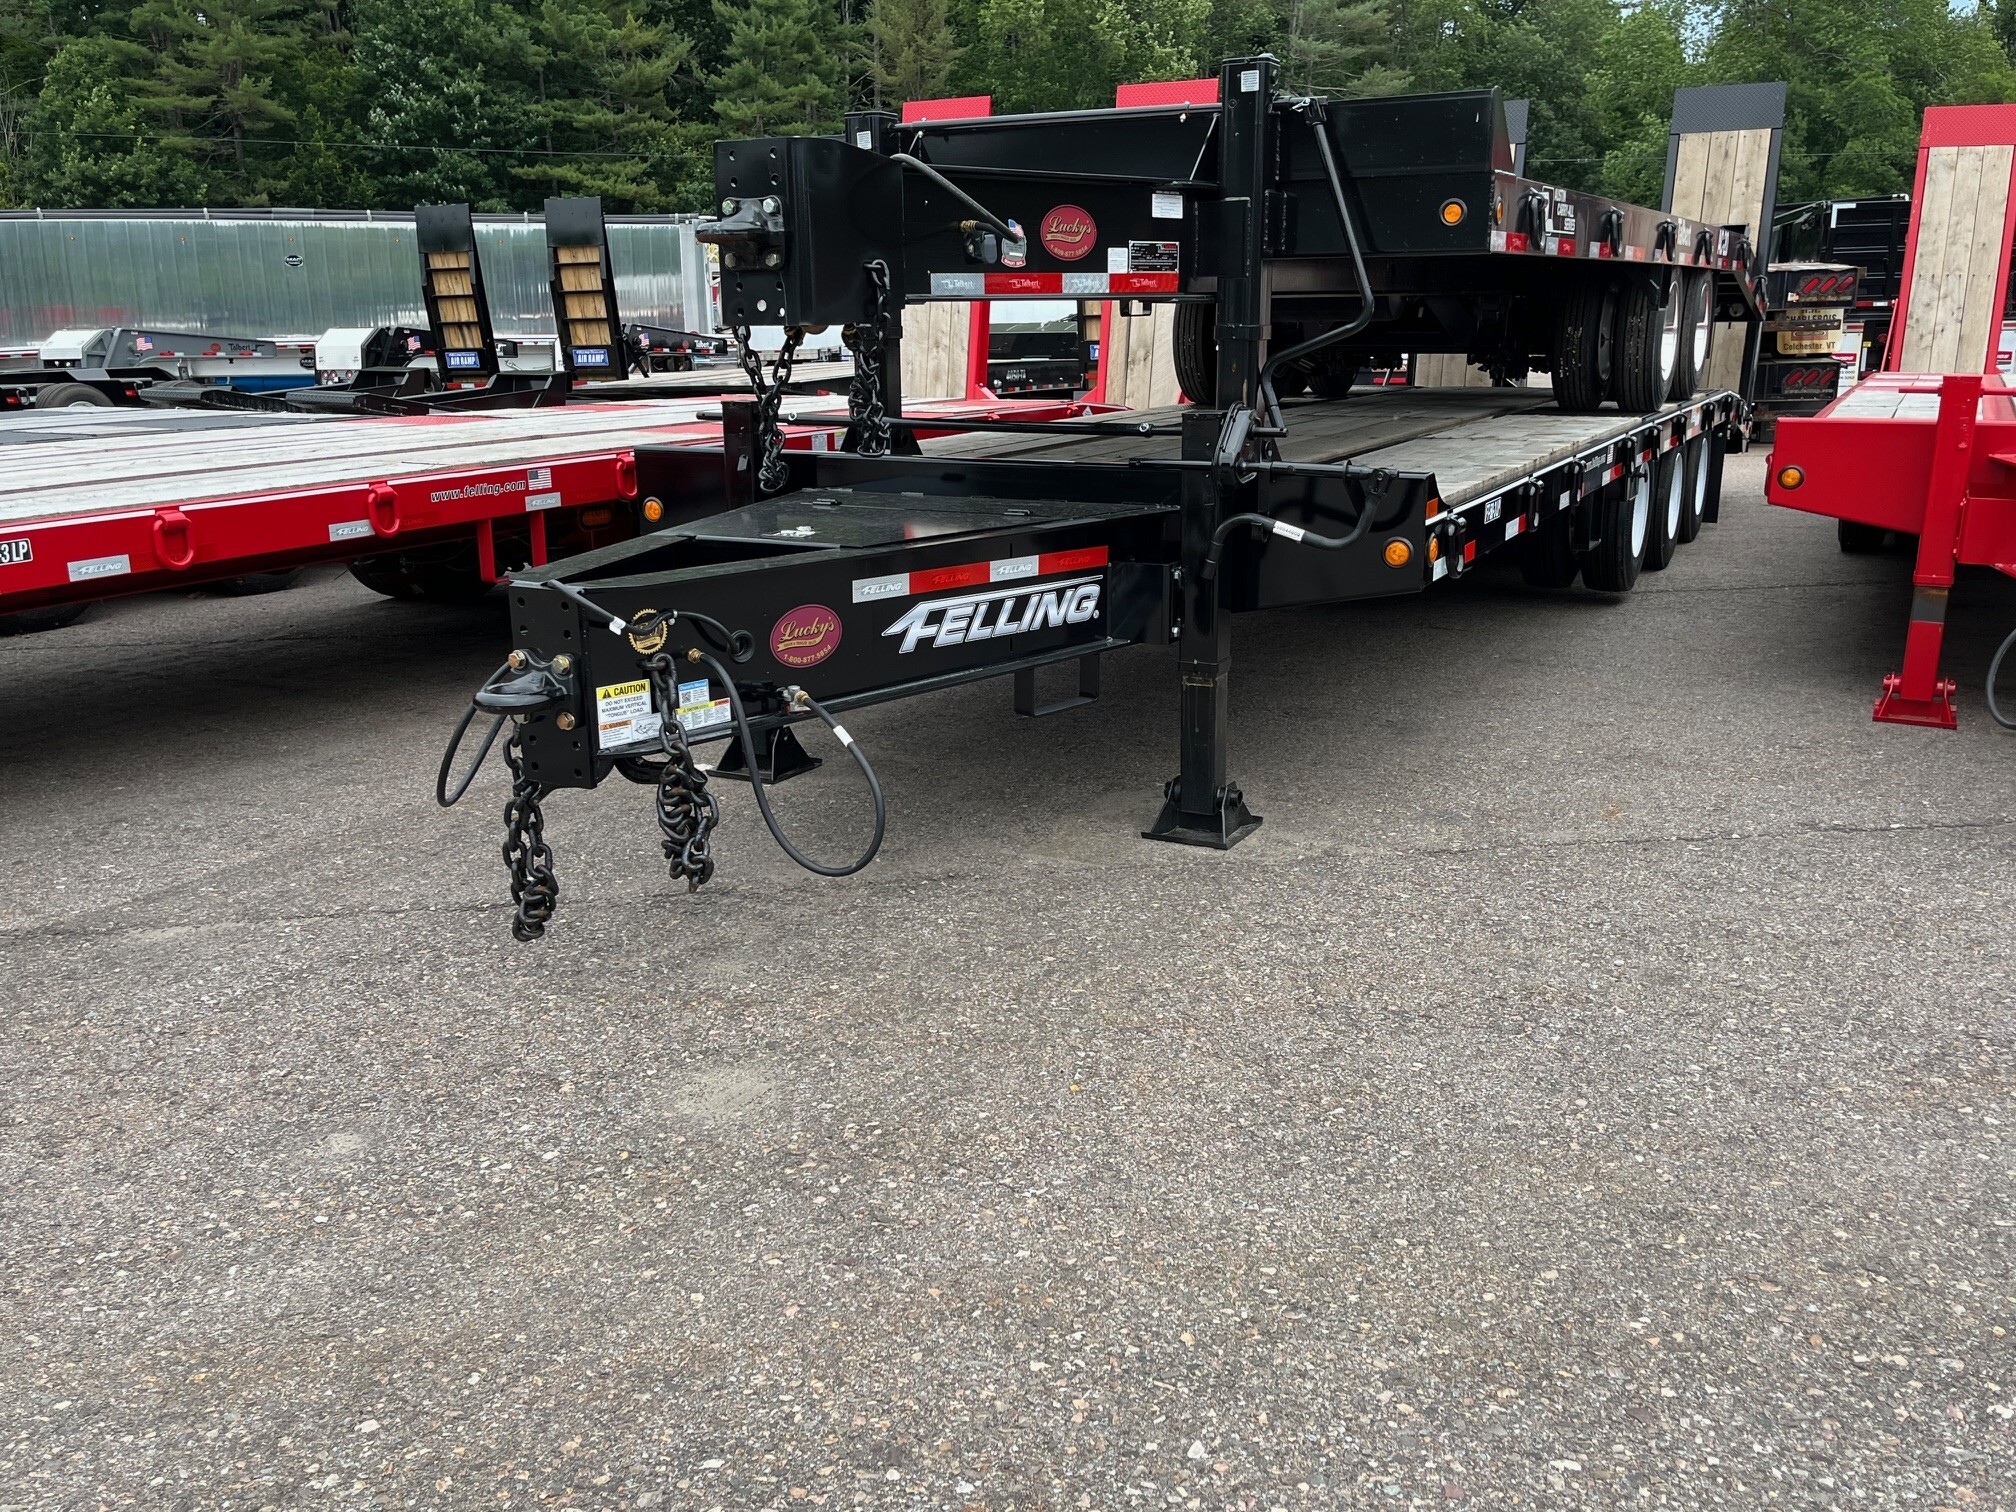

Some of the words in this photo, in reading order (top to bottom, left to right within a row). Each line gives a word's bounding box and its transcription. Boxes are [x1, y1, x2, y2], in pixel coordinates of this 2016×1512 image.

[1048, 216, 1091, 234] Lucky's
[1826, 341, 1836, 349] VT
[451, 357, 460, 365] AIR
[577, 354, 587, 363] AIR
[431, 480, 526, 502] www.felling.com
[79, 562, 122, 575] FELLING
[861, 582, 902, 595] FELLING
[997, 563, 1033, 575] FELLING
[779, 617, 834, 641] Lucky's
[783, 644, 832, 664] 1-800-877-5854
[614, 682, 646, 696] CAUTION
